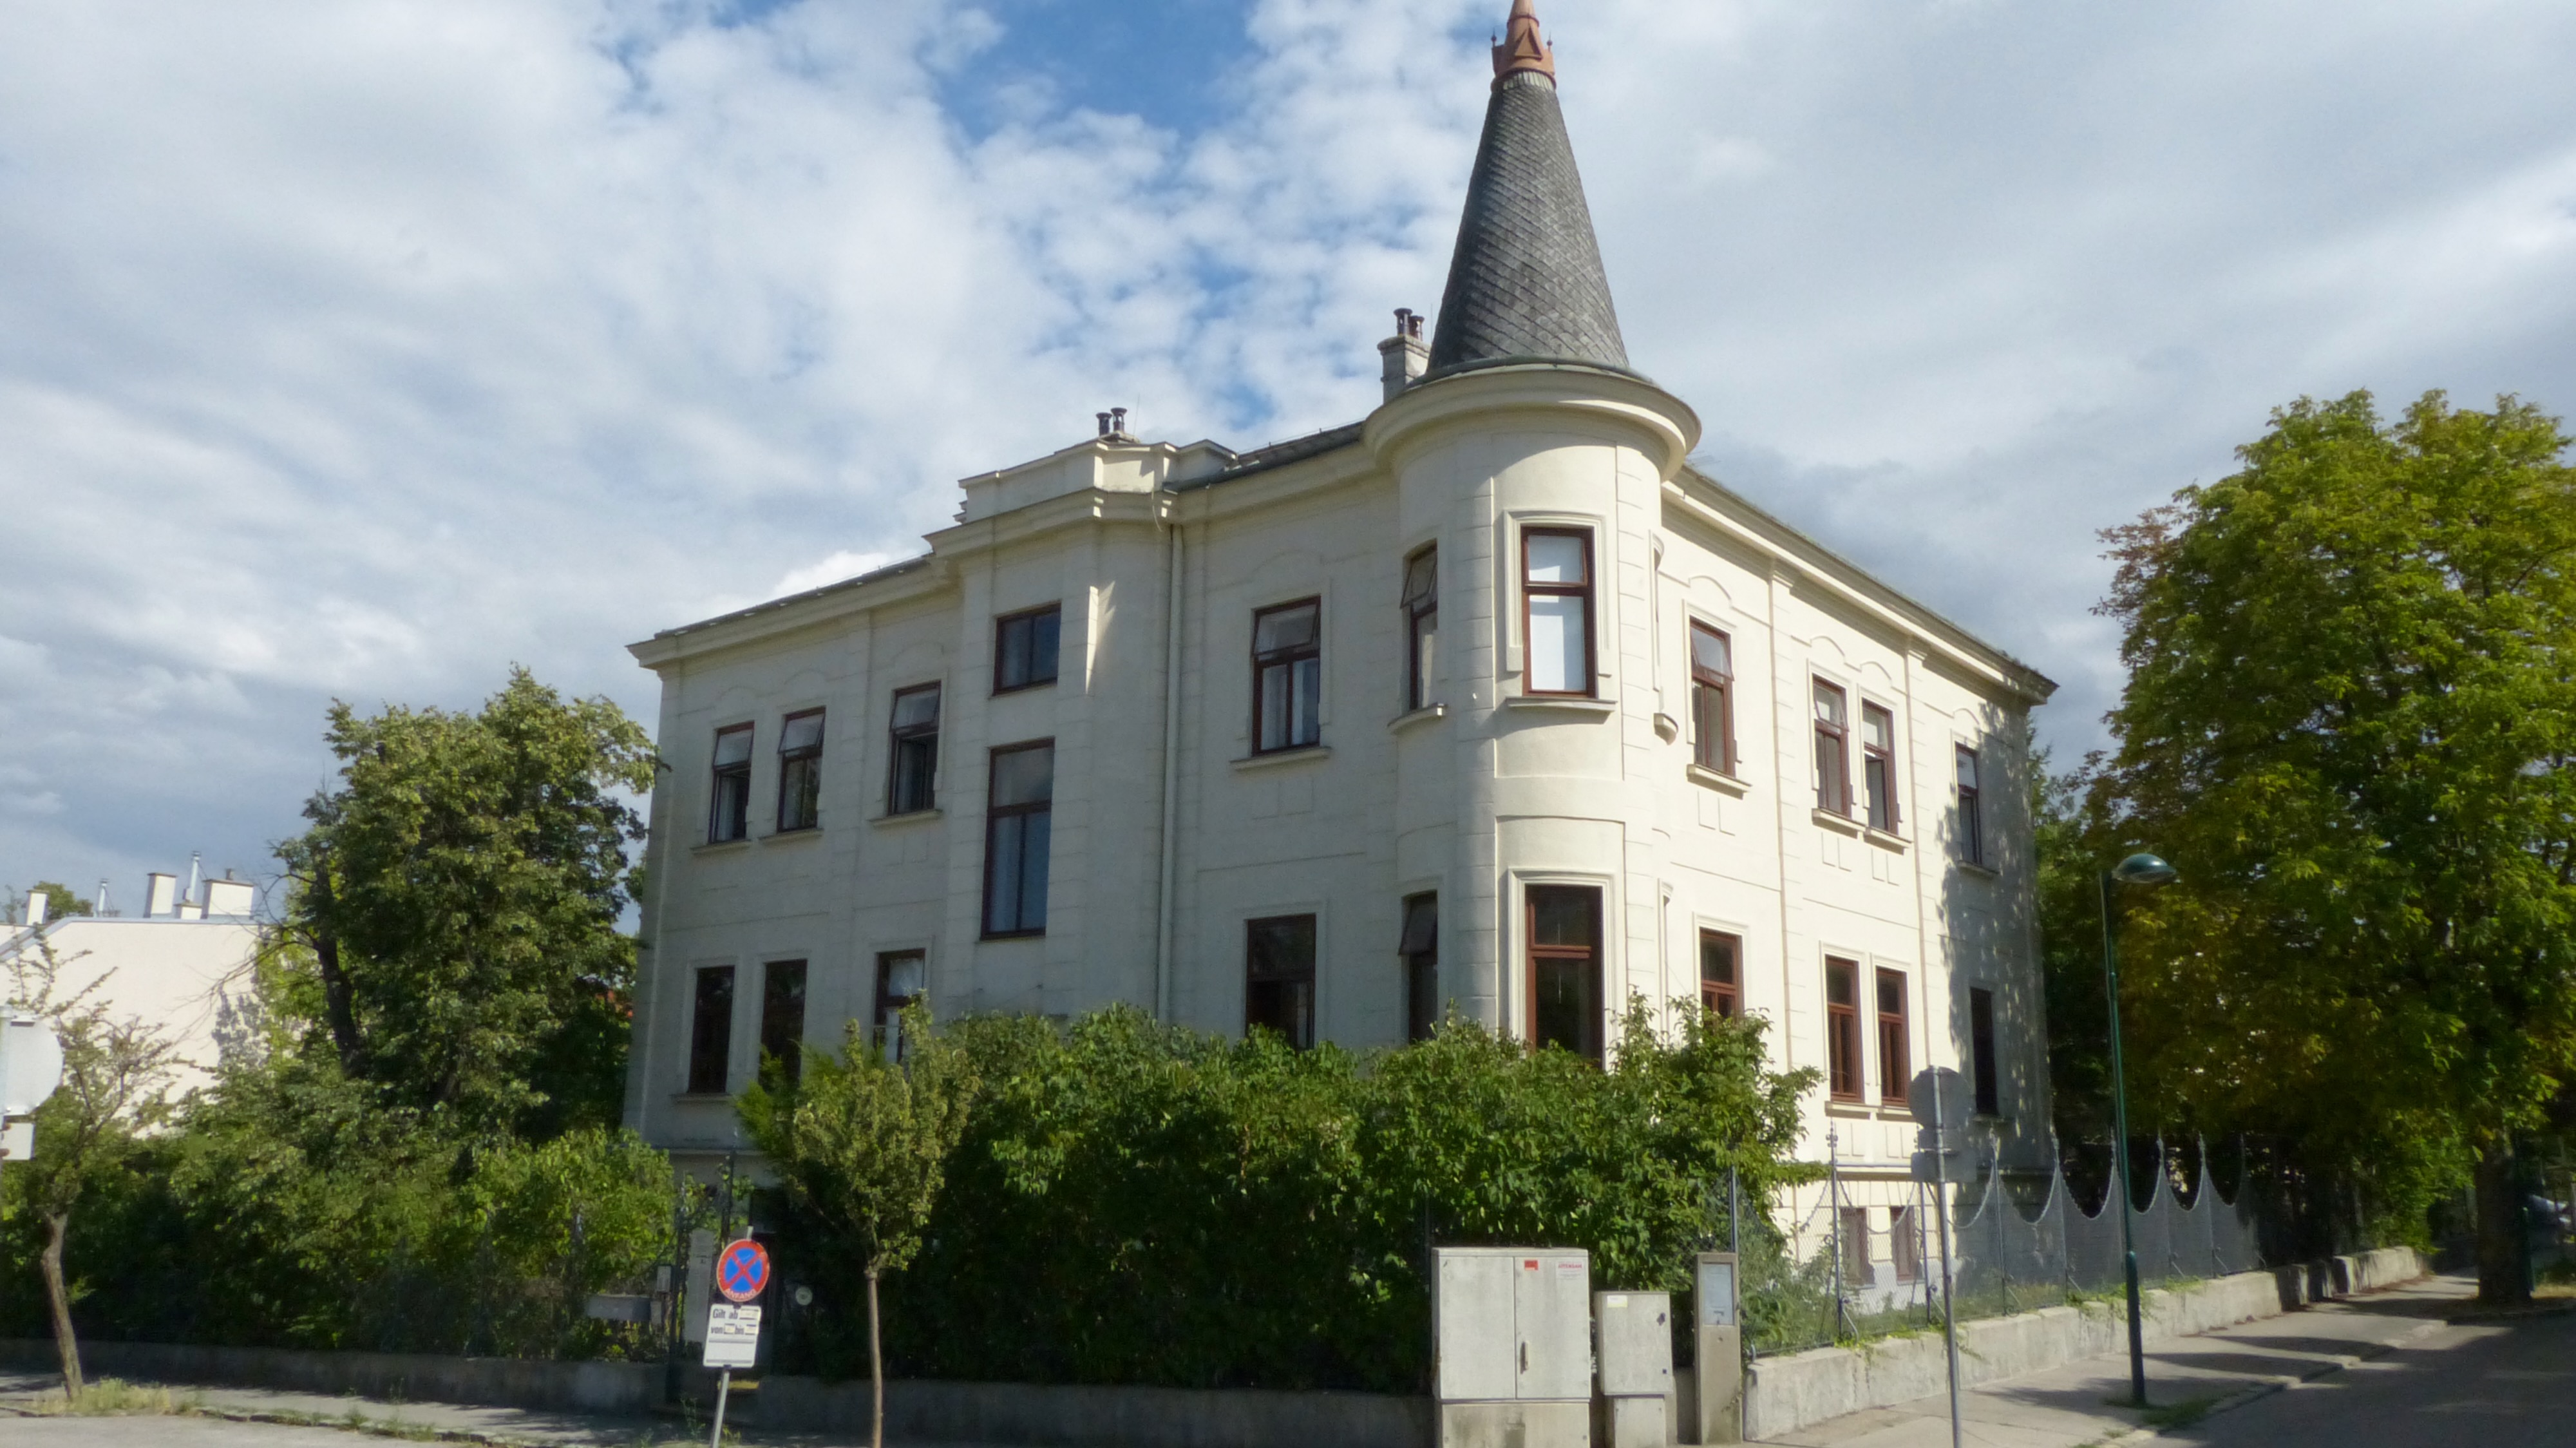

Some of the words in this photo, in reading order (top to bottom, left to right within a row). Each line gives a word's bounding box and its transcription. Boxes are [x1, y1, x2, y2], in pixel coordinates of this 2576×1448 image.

[724, 1288, 757, 1300] ANFANG
[713, 1309, 726, 1319] Gilt
[728, 1310, 738, 1319] ab
[734, 1324, 744, 1335] bis
